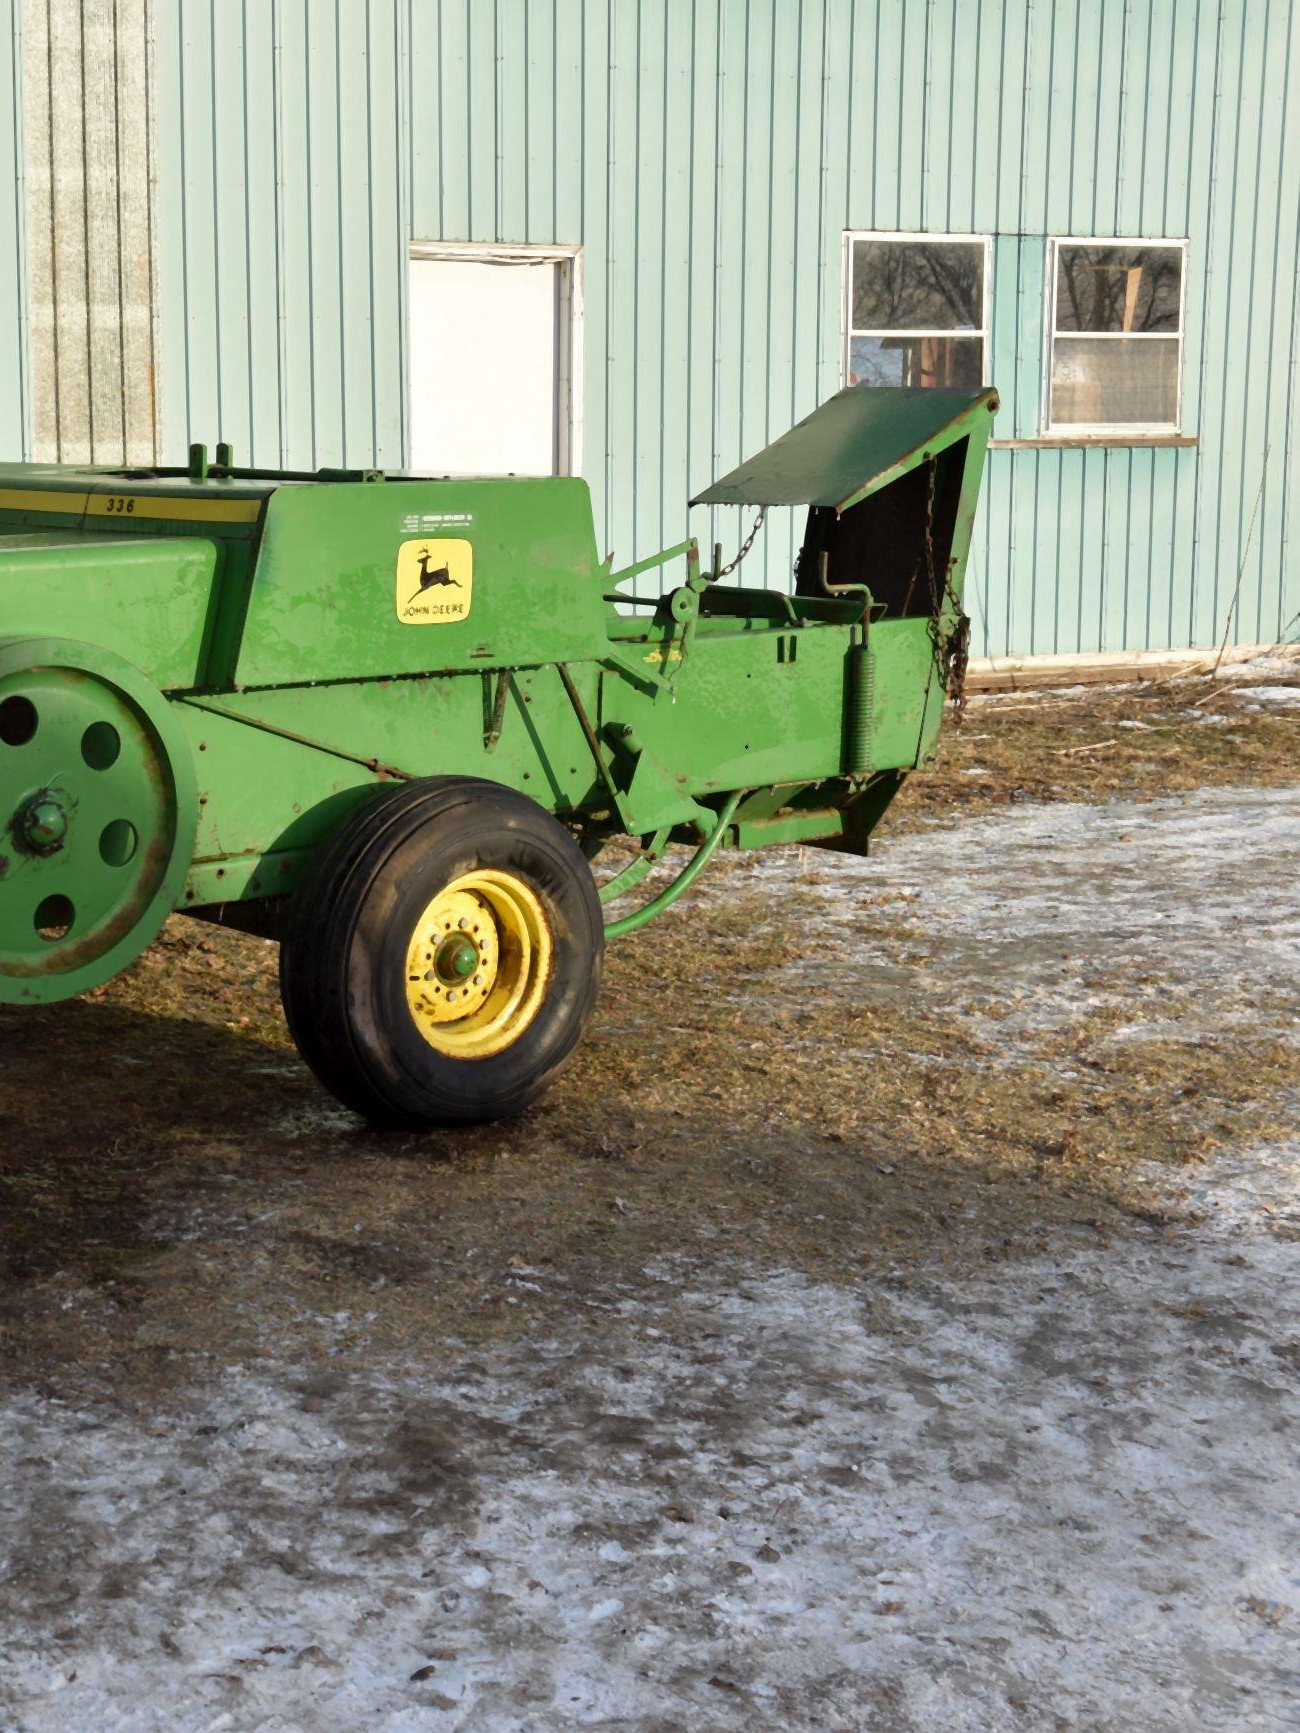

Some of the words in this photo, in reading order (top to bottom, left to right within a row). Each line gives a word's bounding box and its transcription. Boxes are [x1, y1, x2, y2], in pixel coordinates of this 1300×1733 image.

[106, 498, 135, 513] 336
[403, 606, 429, 617] JOHN
[432, 603, 464, 615] DEERE
